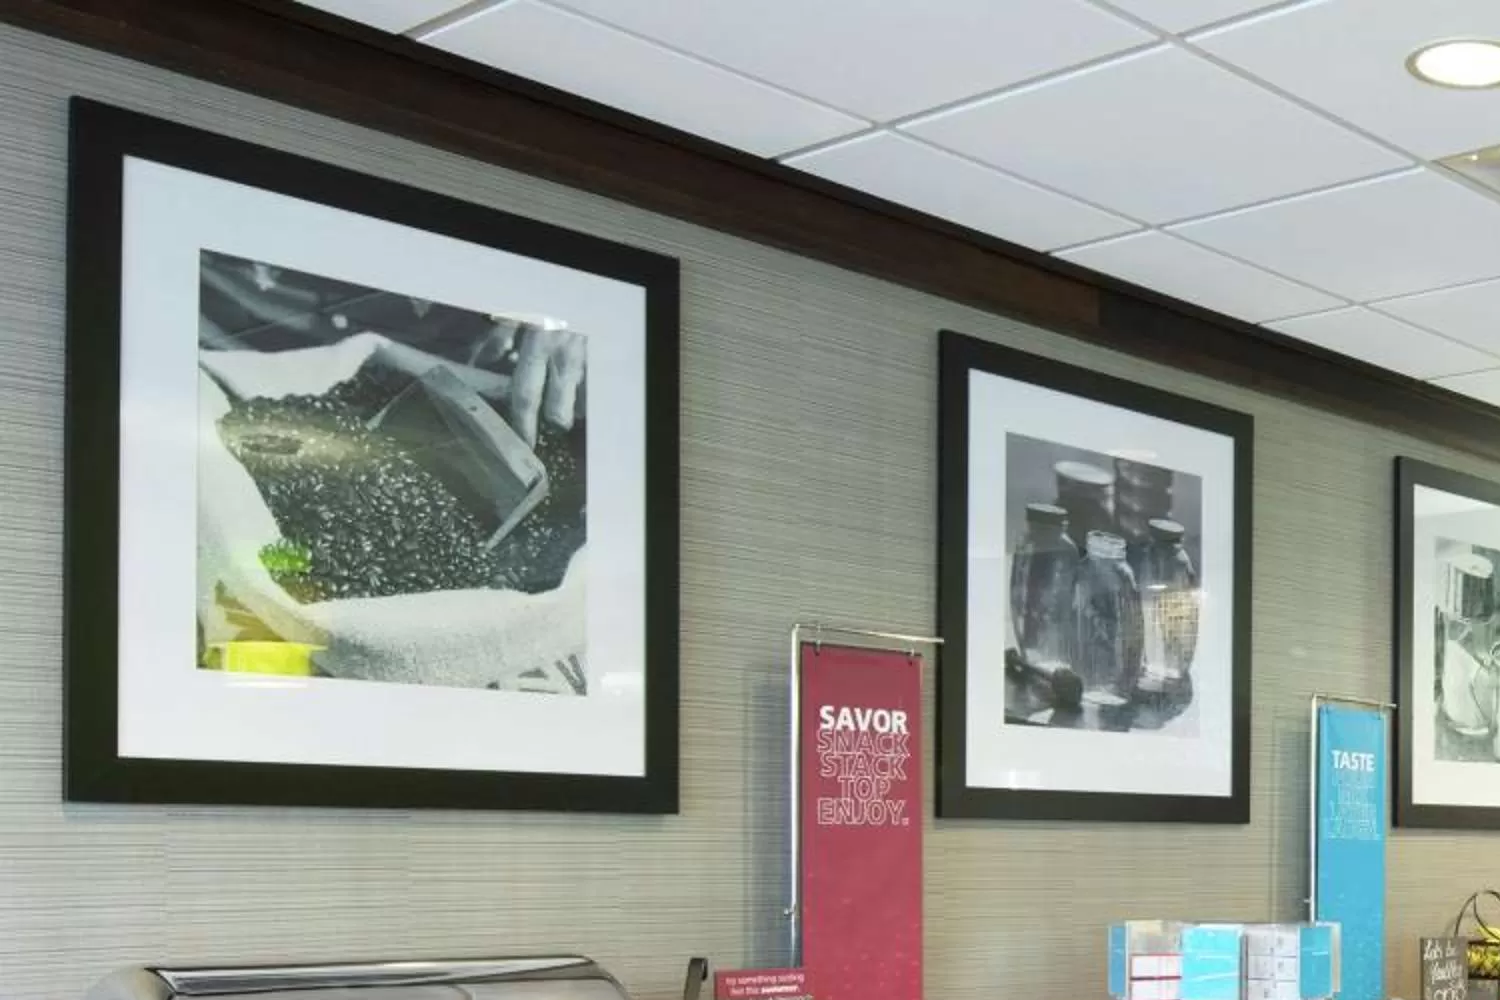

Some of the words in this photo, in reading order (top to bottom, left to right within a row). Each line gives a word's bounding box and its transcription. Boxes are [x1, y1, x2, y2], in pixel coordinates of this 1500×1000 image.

[819, 704, 908, 735] SAVOR
[816, 730, 910, 757] SNACK
[819, 752, 908, 780] STACK
[1331, 749, 1376, 772] TASTE
[836, 775, 891, 801] TOP
[817, 797, 910, 825] ENJOY.
